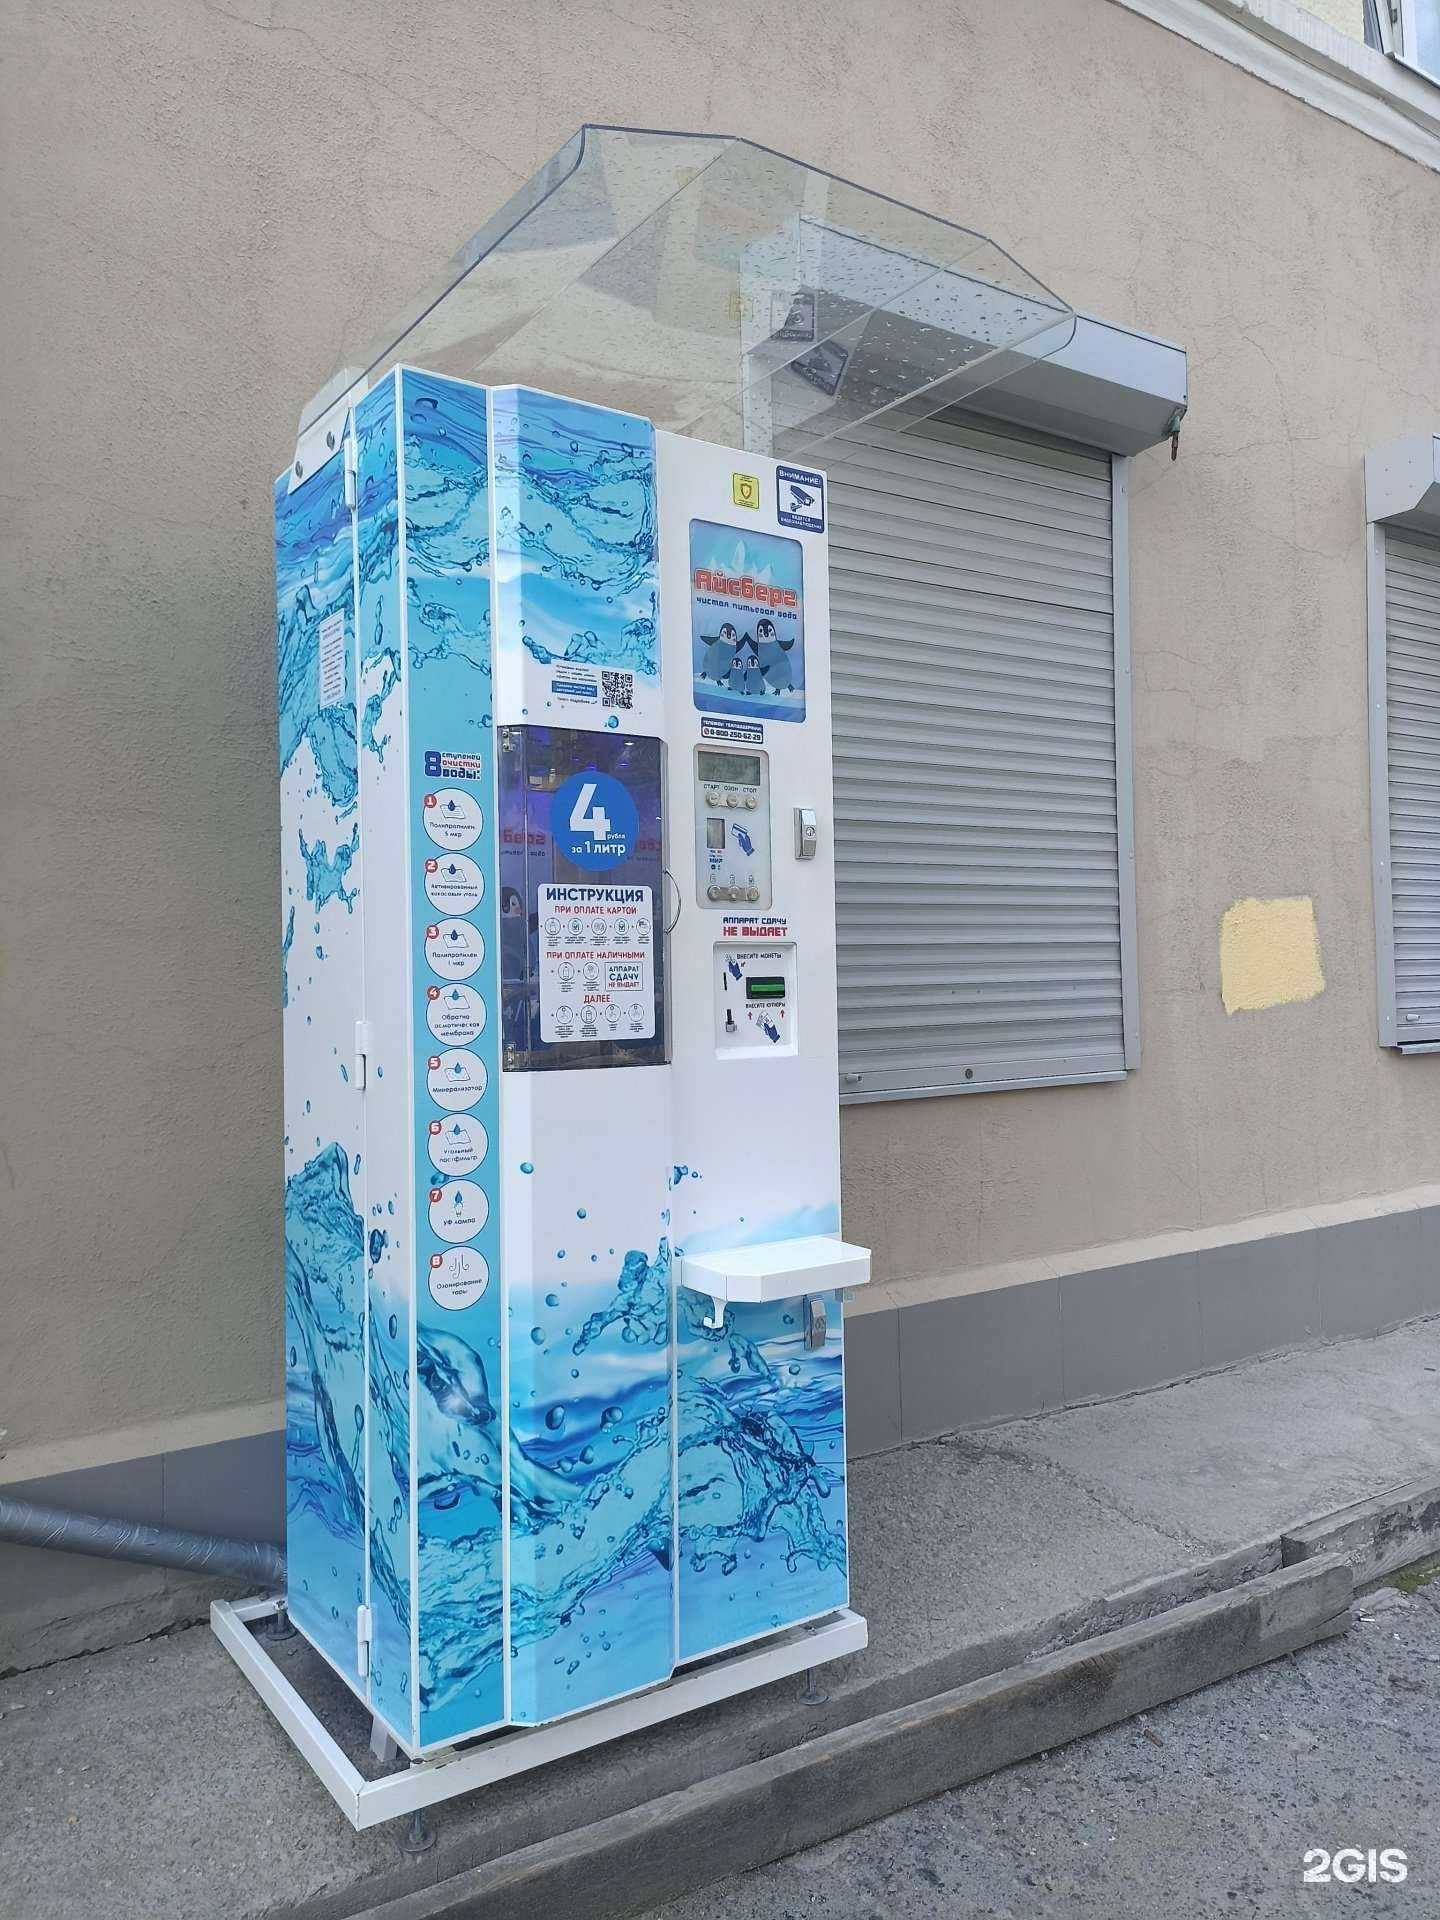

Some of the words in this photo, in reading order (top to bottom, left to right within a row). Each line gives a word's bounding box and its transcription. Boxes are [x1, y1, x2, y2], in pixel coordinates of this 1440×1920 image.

[695, 568, 797, 607] Айсберг
[696, 596, 729, 608] чистая
[732, 603, 775, 616] питьевая
[777, 610, 797, 620] вода
[424, 751, 442, 777] 8
[442, 760, 480, 768] очистки
[569, 783, 611, 840] 4
[607, 832, 626, 840] рубля
[571, 845, 583, 854] за
[584, 841, 591, 854] 1
[593, 843, 626, 857] литр
[546, 887, 644, 903] ИНСТРУКЦИЯ
[554, 905, 571, 914] ПРИ
[573, 906, 604, 915] ОПЛАТЕ
[606, 905, 637, 915] КАРТОЙ
[723, 916, 760, 924] АППАРАТ
[761, 917, 787, 925] СДАЧУ
[723, 926, 738, 937] НЕ
[741, 926, 788, 937] ВЫДАЕТ
[546, 951, 563, 959] ПРИ
[564, 951, 594, 960] ОПЛАТЕ
[596, 951, 645, 960] НАЛИЧНЫМИ
[760, 952, 782, 960] МОНЕТЫ
[609, 973, 639, 982] СДАЧУ
[583, 994, 611, 1004] ДАЛЕЕ
